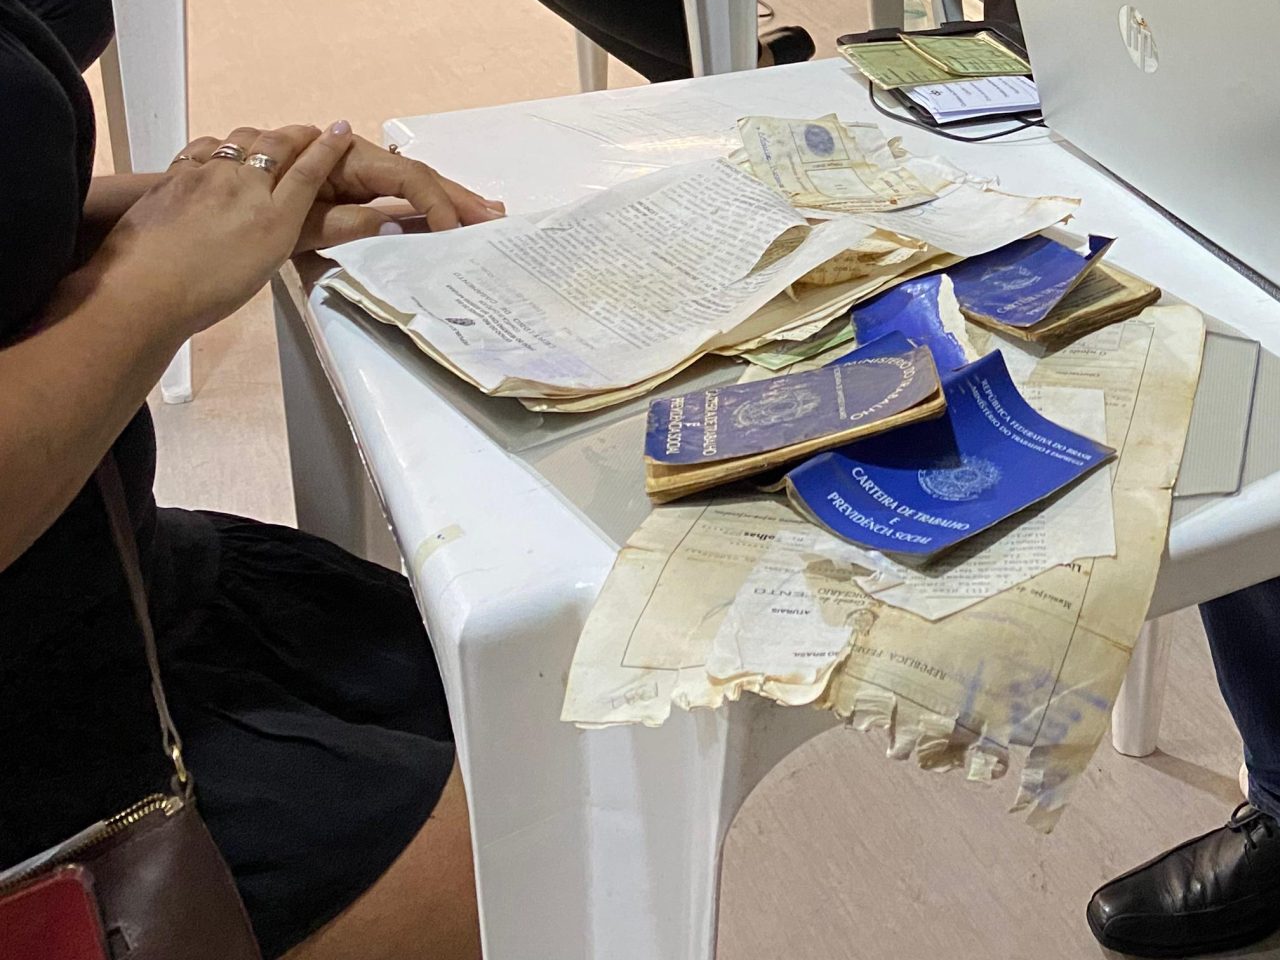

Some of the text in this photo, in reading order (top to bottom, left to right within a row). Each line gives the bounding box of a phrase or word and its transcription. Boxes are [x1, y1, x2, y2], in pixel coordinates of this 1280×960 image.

[972, 386, 1000, 428] MINISTÉRIO
[999, 426, 1012, 436] DO
[1011, 434, 1046, 452] TRABALHO
[1050, 451, 1084, 466] EMPREGO
[982, 379, 1092, 460] REPÚBLICA FEDERATIVA DO BRASIL
[827, 491, 894, 536] PREVIDÊNCIA
[892, 531, 932, 544] SOCIAL
[852, 467, 899, 510] CARTEIRA
[897, 505, 915, 517] DE
[914, 512, 970, 531] TRABALHO
[889, 517, 900, 525] E
[744, 531, 779, 540] olhas
[754, 588, 808, 598] ENTO
